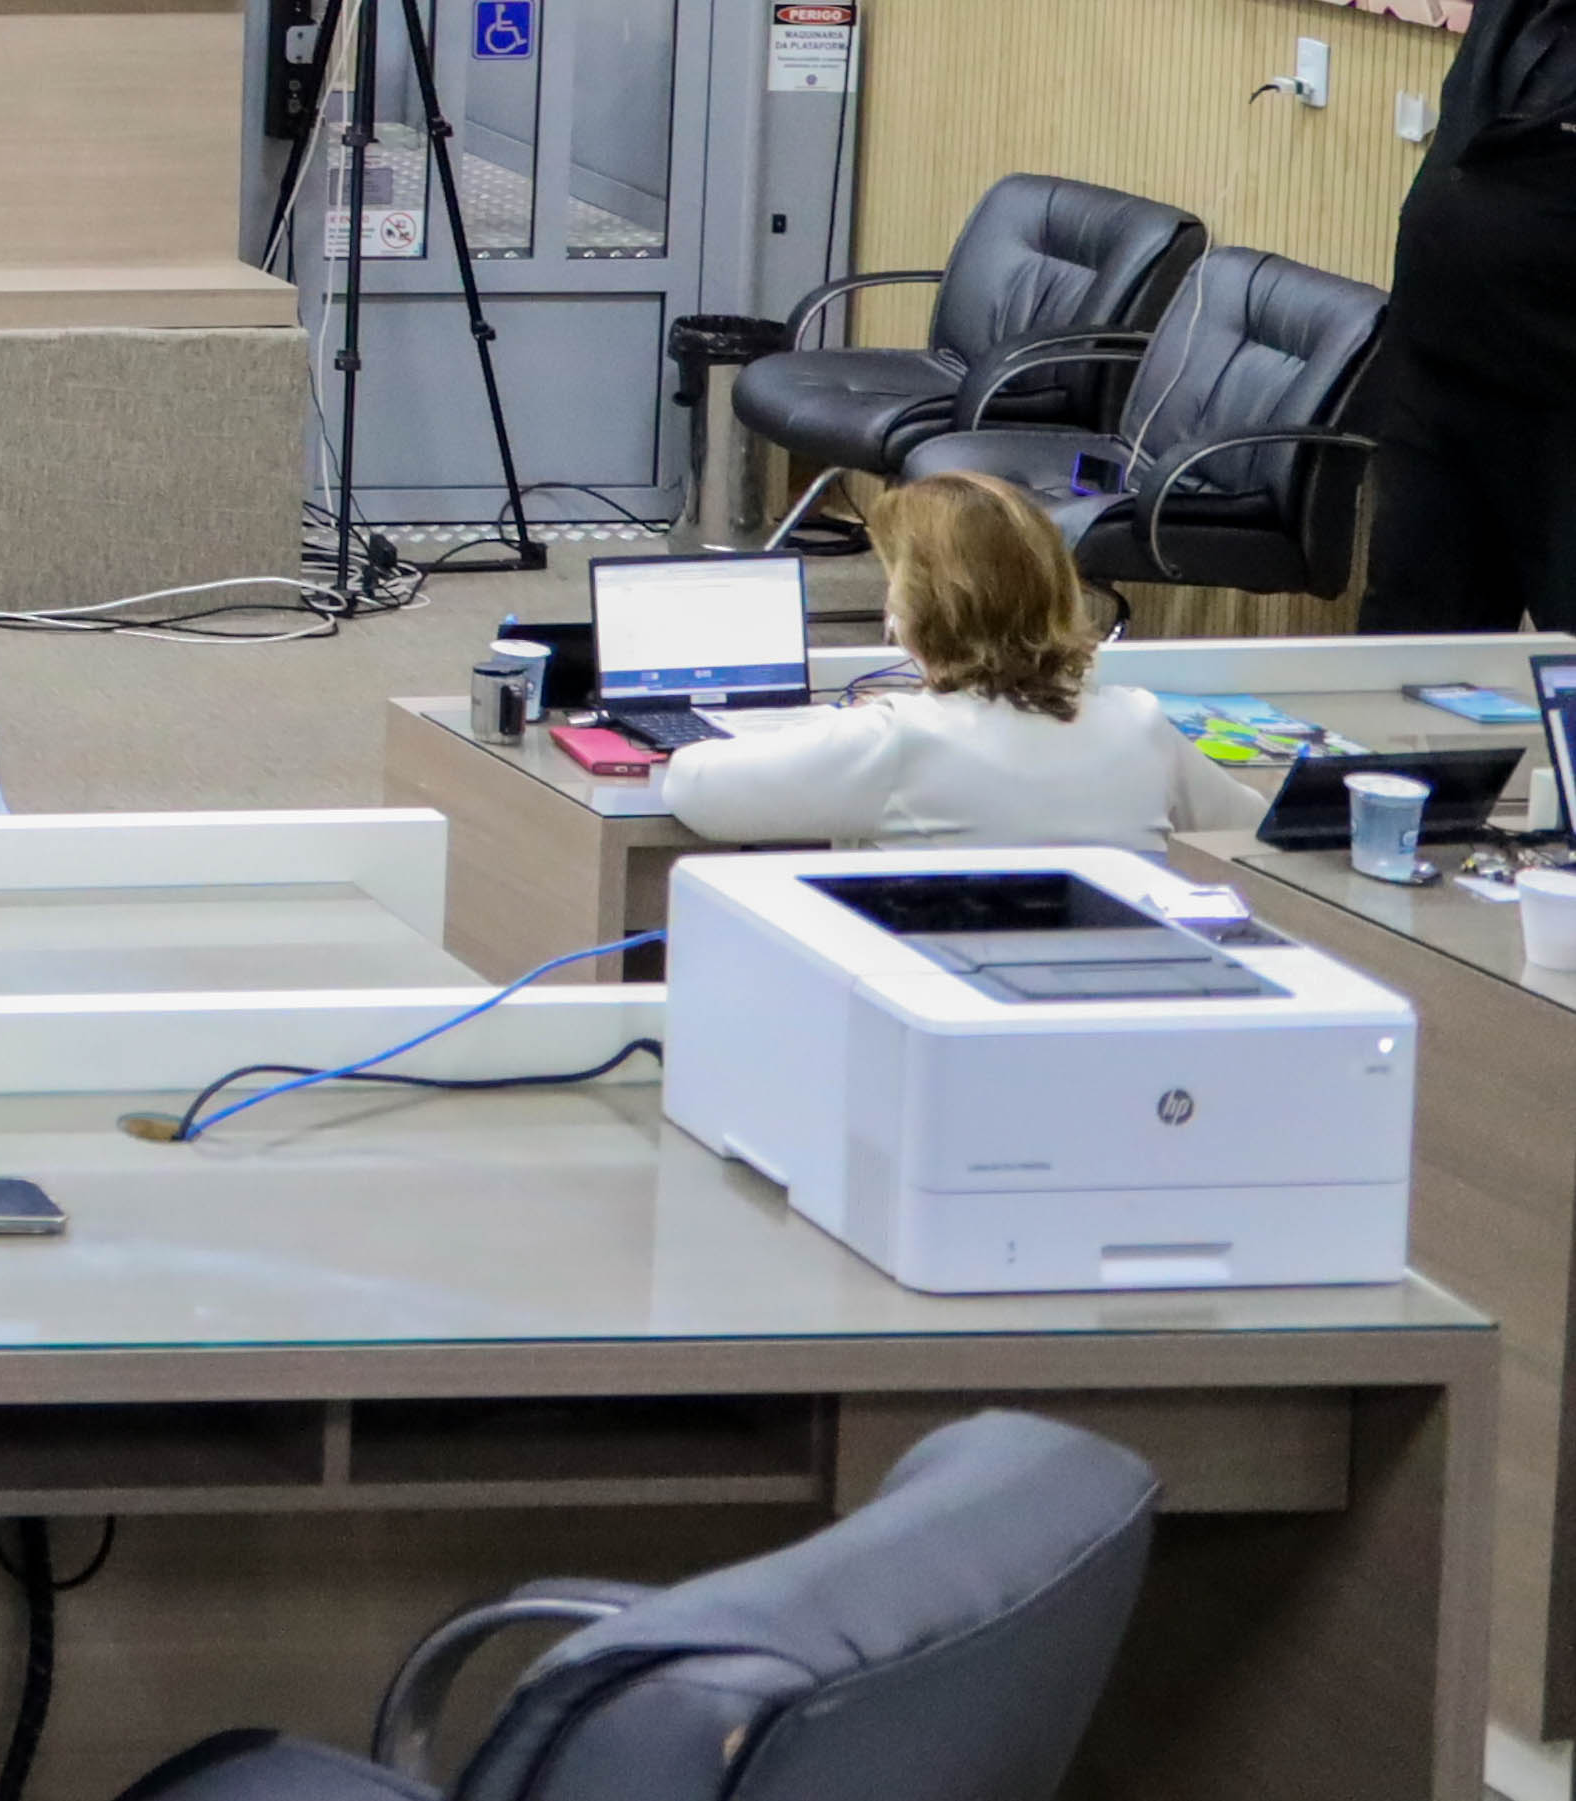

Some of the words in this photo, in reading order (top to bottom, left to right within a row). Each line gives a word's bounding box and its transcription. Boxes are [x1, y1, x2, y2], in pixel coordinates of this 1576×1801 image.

[789, 10, 842, 21] PERIGO
[790, 41, 849, 50] PLATAFORM
[1161, 1089, 1191, 1125] hp
